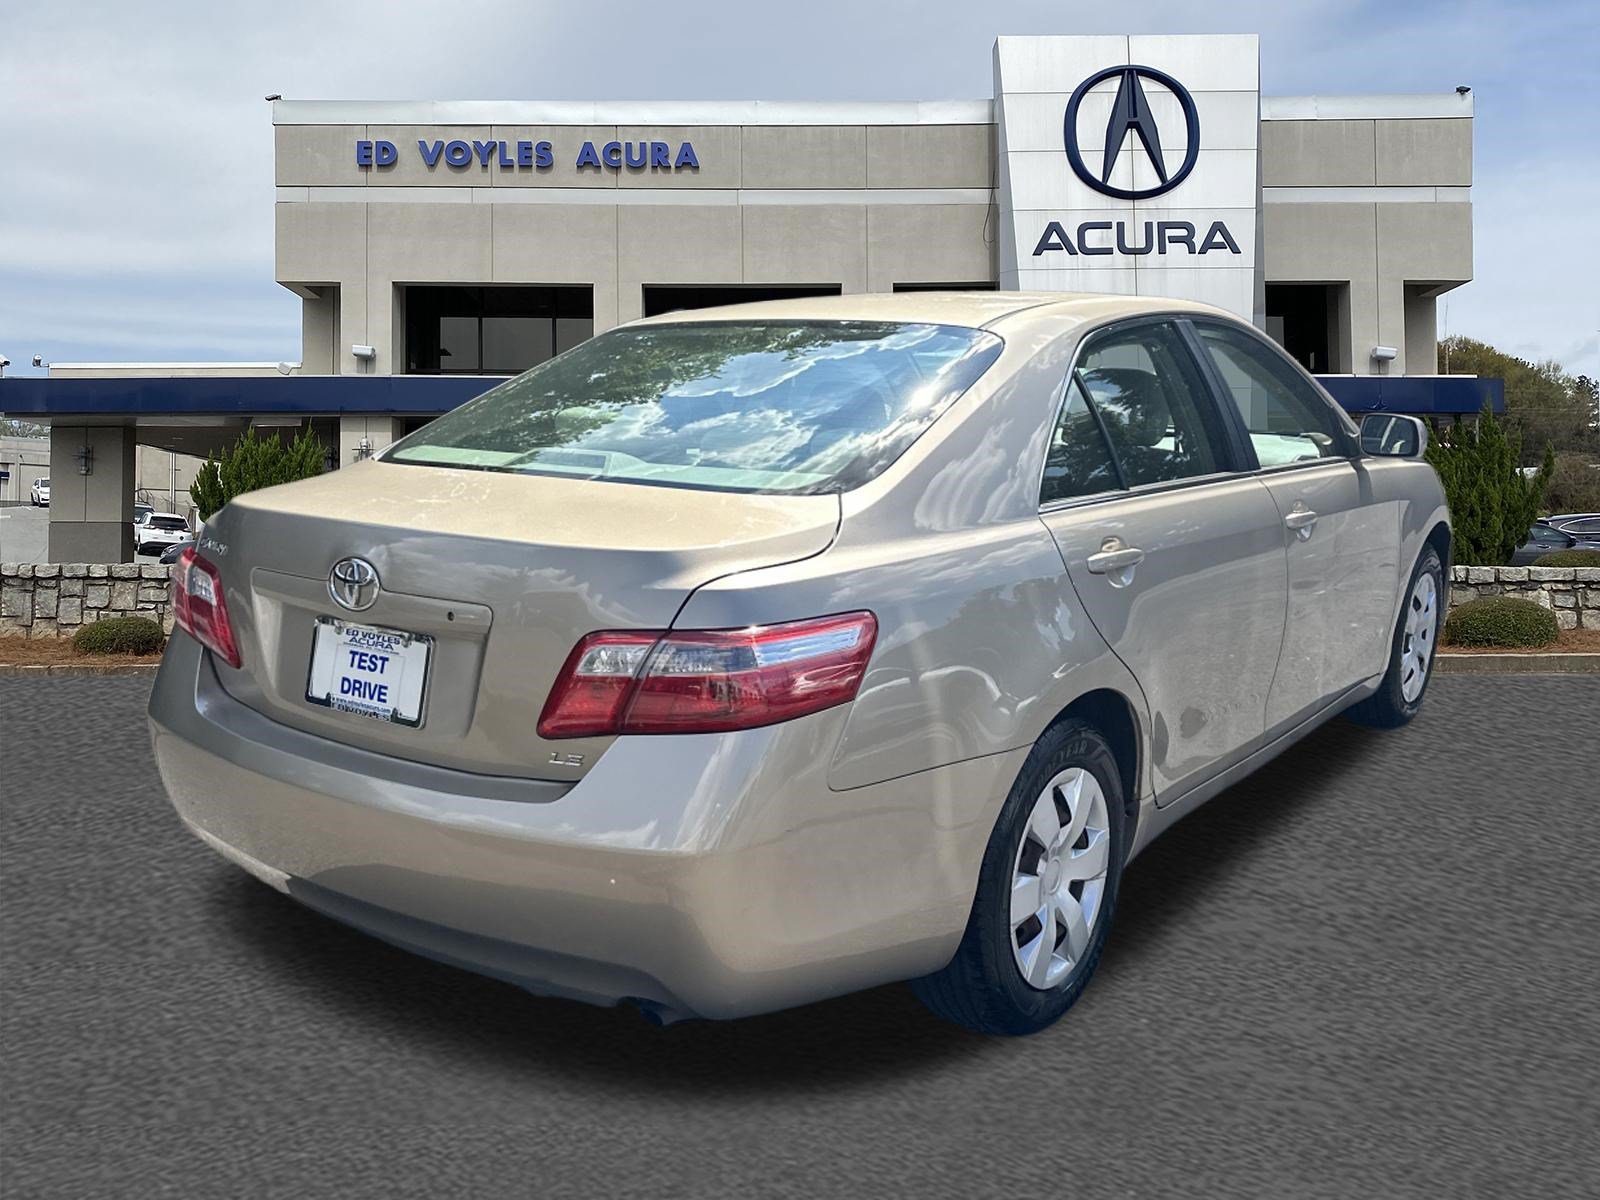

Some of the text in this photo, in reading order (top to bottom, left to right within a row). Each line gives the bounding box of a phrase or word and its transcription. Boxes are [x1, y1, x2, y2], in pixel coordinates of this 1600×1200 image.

[356, 140, 700, 169] ED VOYLES ACURA
[1032, 221, 1242, 256] ACURA
[345, 628, 401, 645] ED VOYLES
[349, 636, 394, 651] ACURA
[349, 650, 389, 674] TEST
[340, 676, 389, 703] DRIVE
[548, 752, 584, 767] LE
